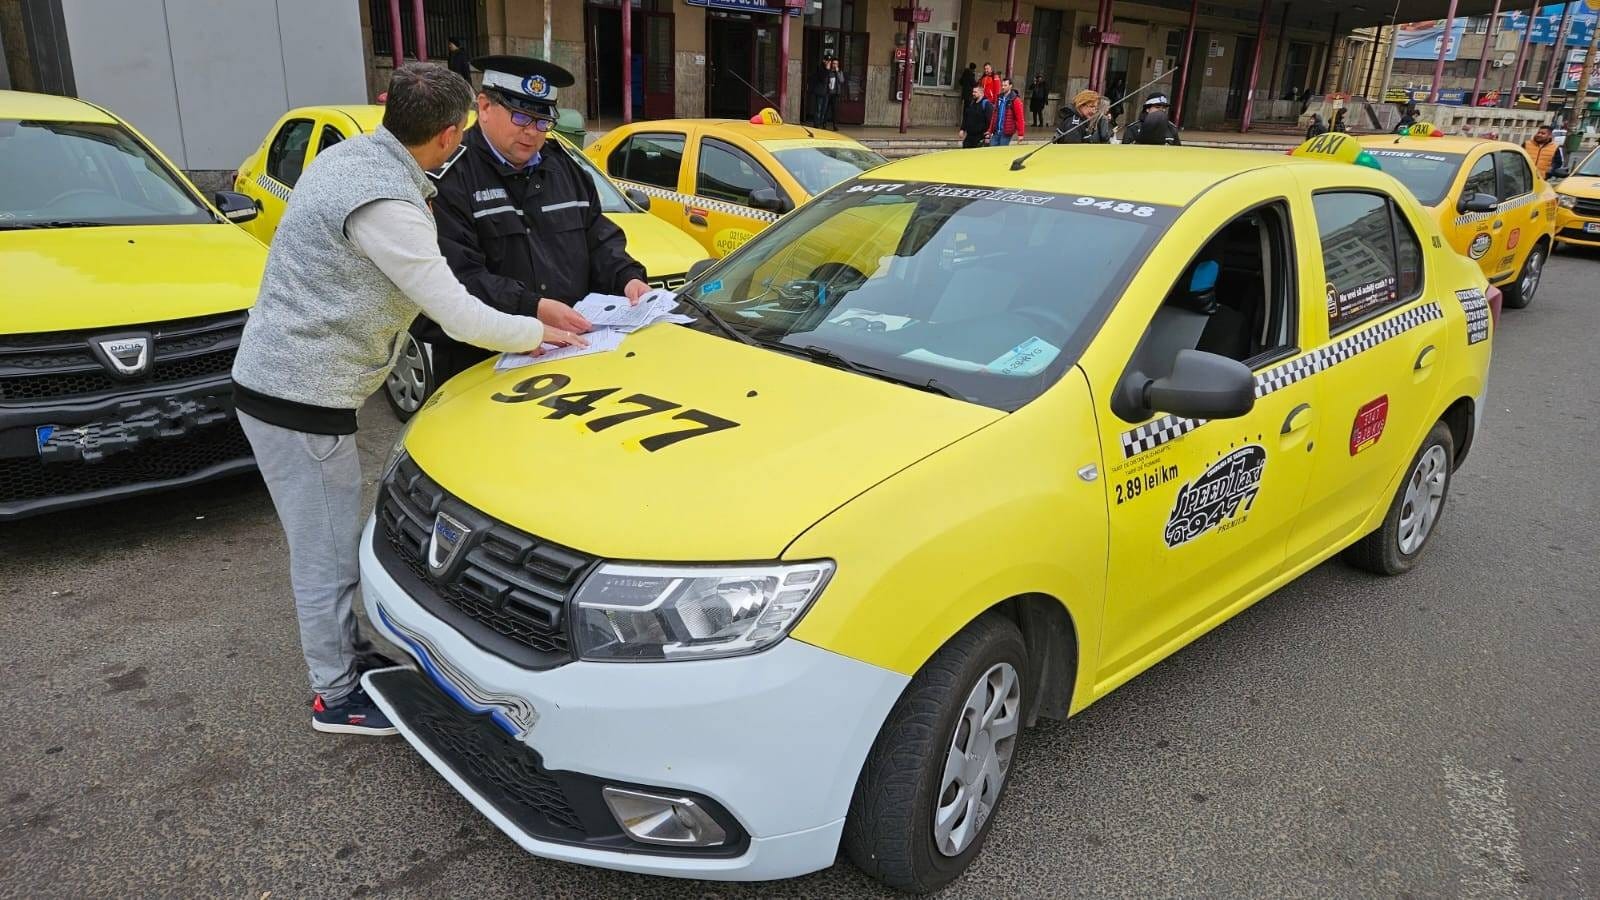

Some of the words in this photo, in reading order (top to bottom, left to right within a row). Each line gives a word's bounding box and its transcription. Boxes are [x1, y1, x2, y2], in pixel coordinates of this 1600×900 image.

[1414, 124, 1428, 135] TAXI
[1305, 134, 1346, 155] TAXI
[846, 183, 904, 194] 9477
[1072, 196, 1156, 218] 9488
[110, 343, 141, 351] DACIA
[490, 373, 741, 453] 9477
[1115, 480, 1142, 505] 2.89
[1144, 464, 1178, 491] lei/km
[1186, 486, 1260, 540] 9477
[1217, 515, 1248, 534] PREMIUM
